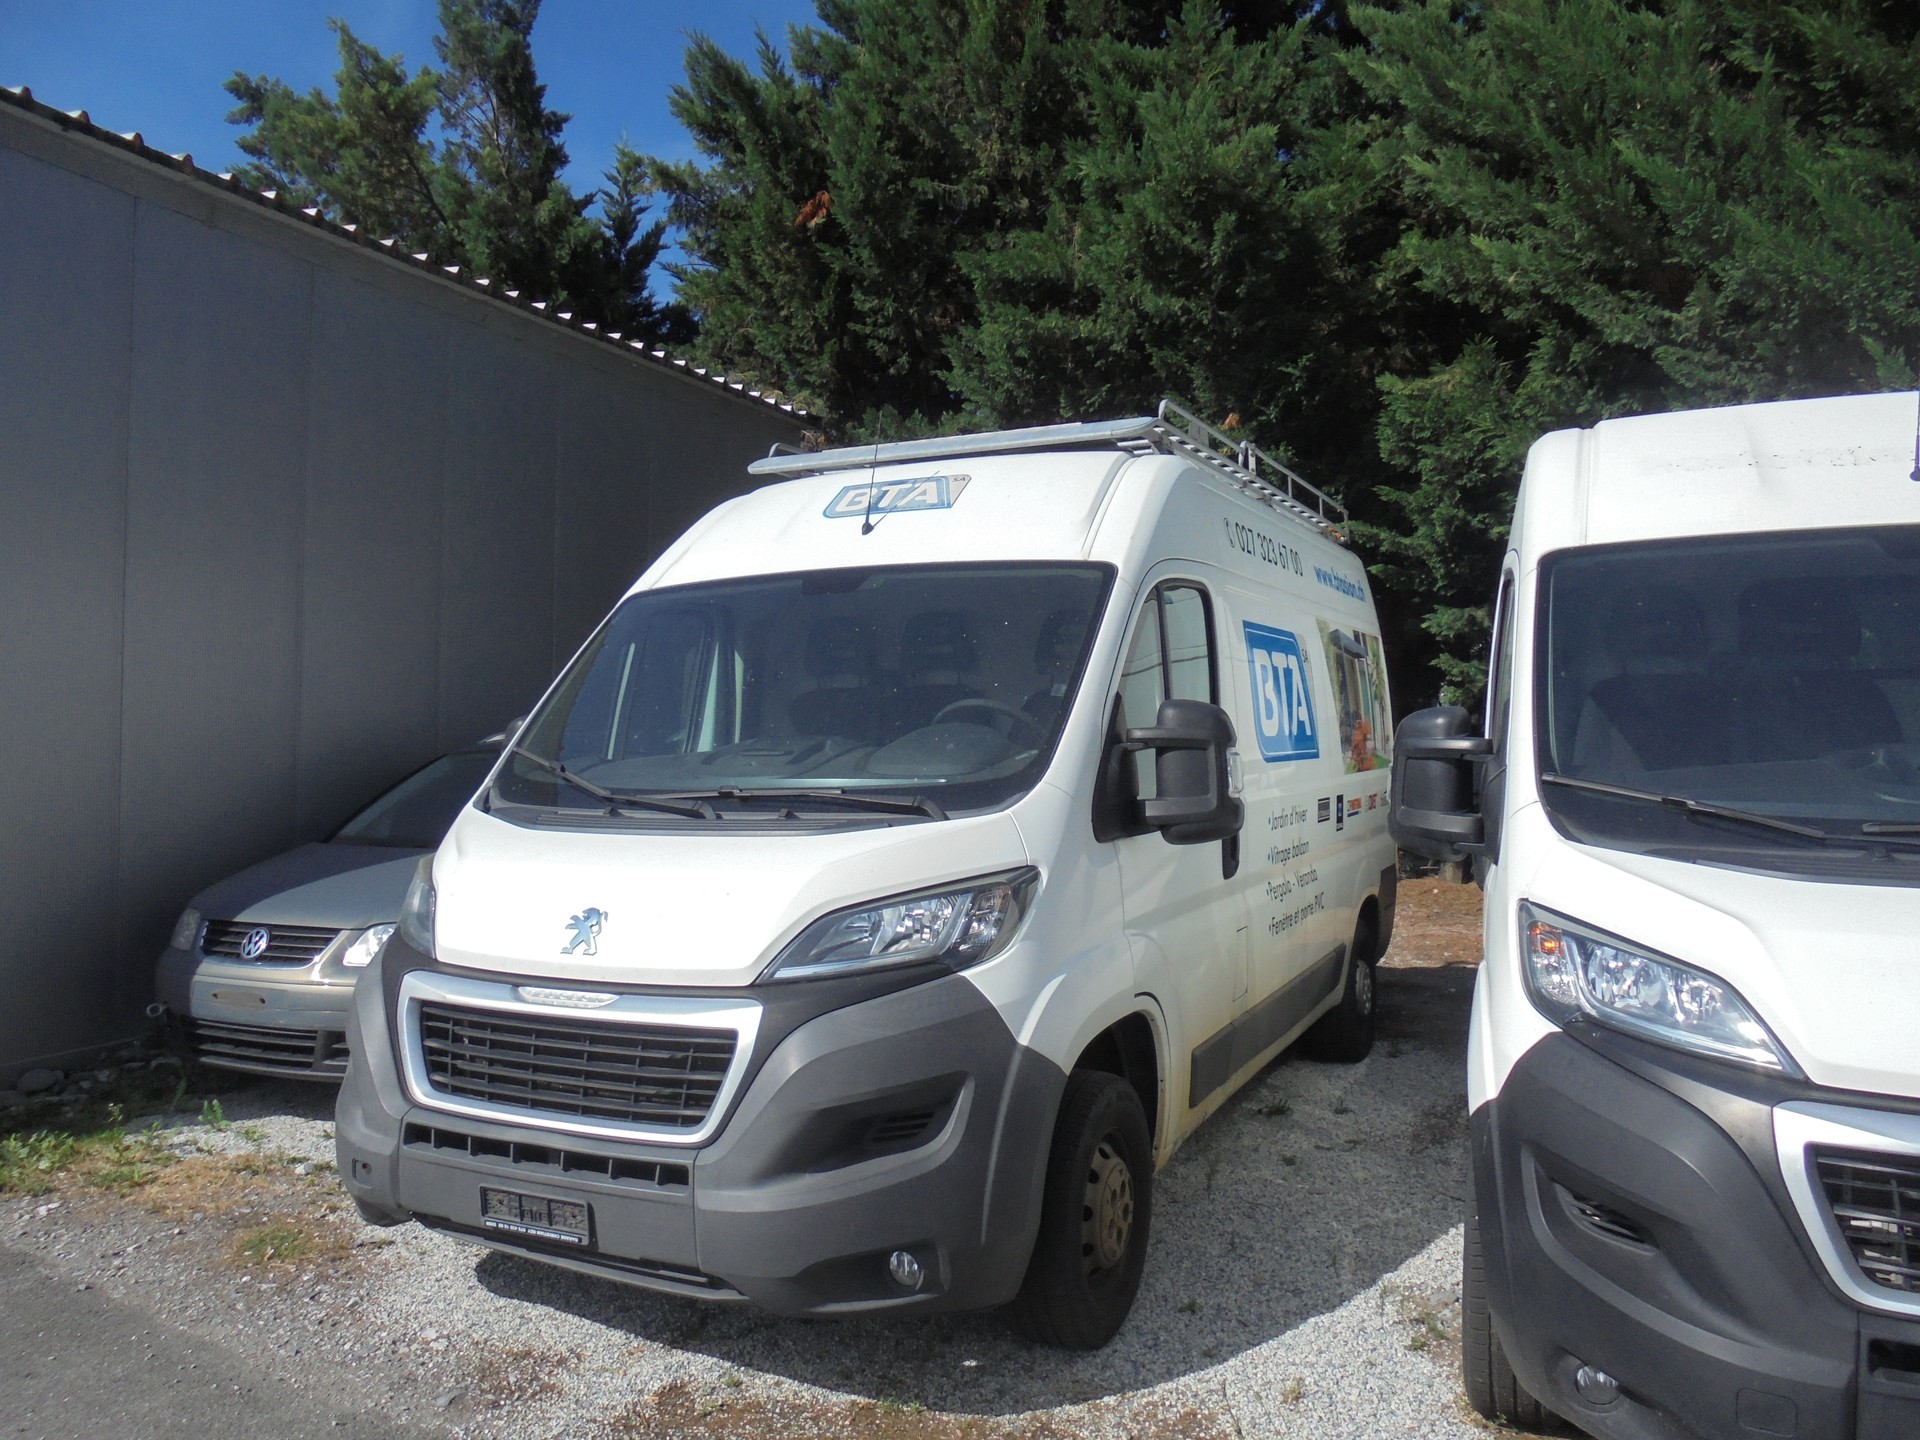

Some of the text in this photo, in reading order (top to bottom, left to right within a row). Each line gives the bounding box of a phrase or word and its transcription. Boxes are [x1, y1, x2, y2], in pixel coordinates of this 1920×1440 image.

[835, 480, 938, 512] BTA
[1235, 522, 1304, 577] 027 323 67 00
[1253, 647, 1312, 737] BTA
[1271, 808, 1289, 831] Jardin
[1270, 837, 1310, 867] Vitrage balcon
[1268, 874, 1292, 902] Pergola
